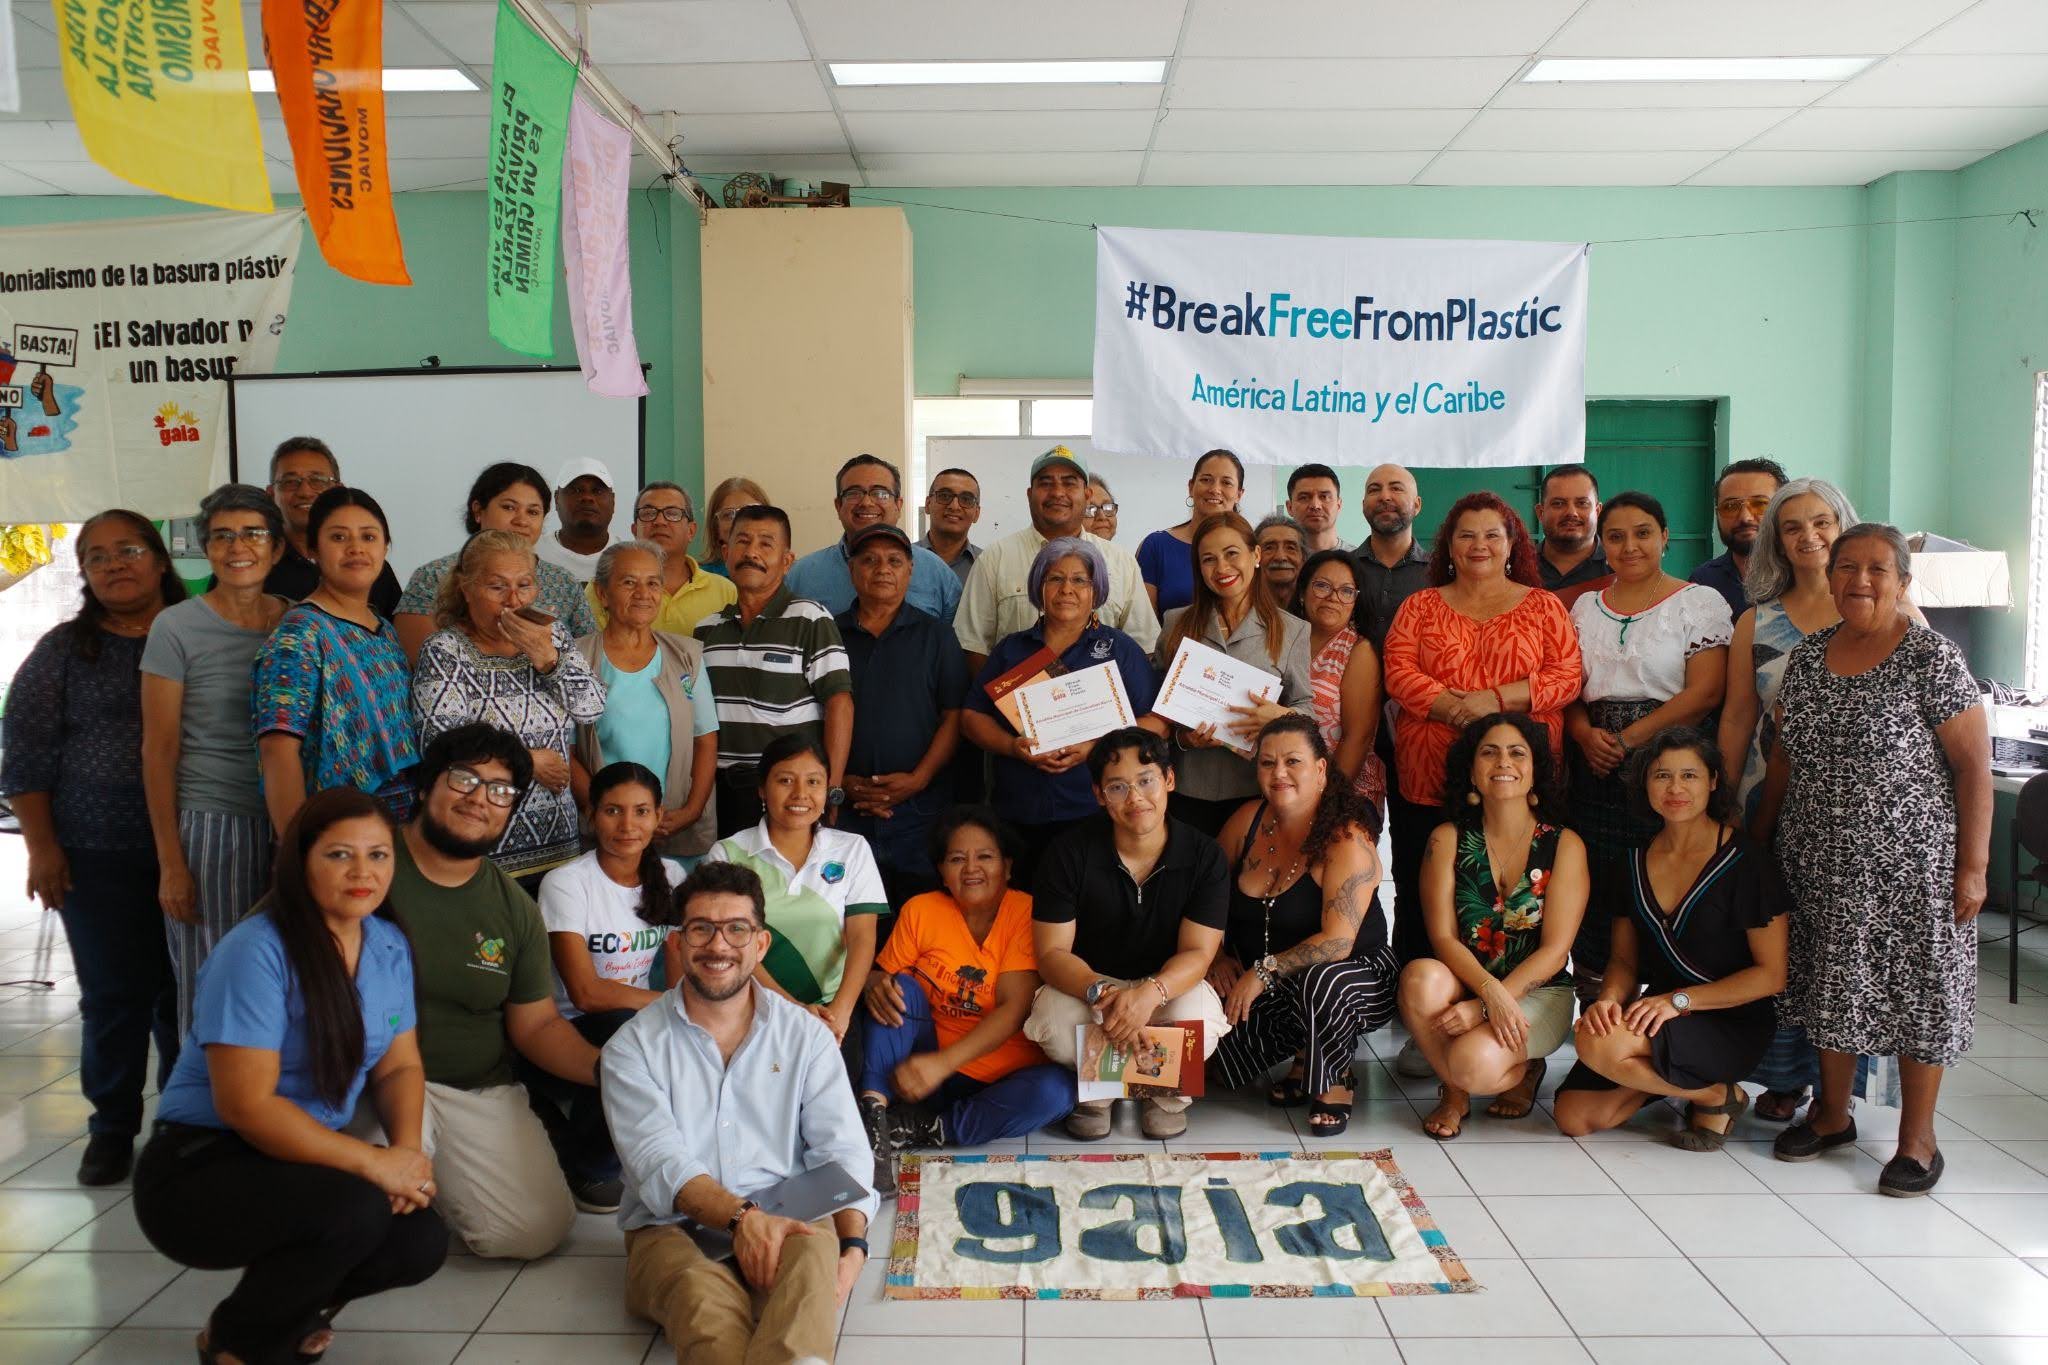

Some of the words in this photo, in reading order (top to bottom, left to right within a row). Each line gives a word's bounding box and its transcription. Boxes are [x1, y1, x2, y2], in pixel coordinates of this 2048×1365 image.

[101, 265, 125, 287] de
[130, 264, 148, 286] la
[153, 259, 220, 284] basura
[1125, 280, 1562, 341] #BreakFreeFromPlastic
[20, 334, 72, 356] BASTA!
[127, 318, 229, 348] Salvador
[129, 360, 158, 383] un
[0, 390, 19, 404] NO
[1191, 373, 1286, 411] América
[1292, 379, 1366, 413] Latina
[1371, 391, 1392, 423] y
[1395, 382, 1419, 415] el
[1423, 381, 1505, 414] Caribe
[952, 1177, 1398, 1265] gaia
